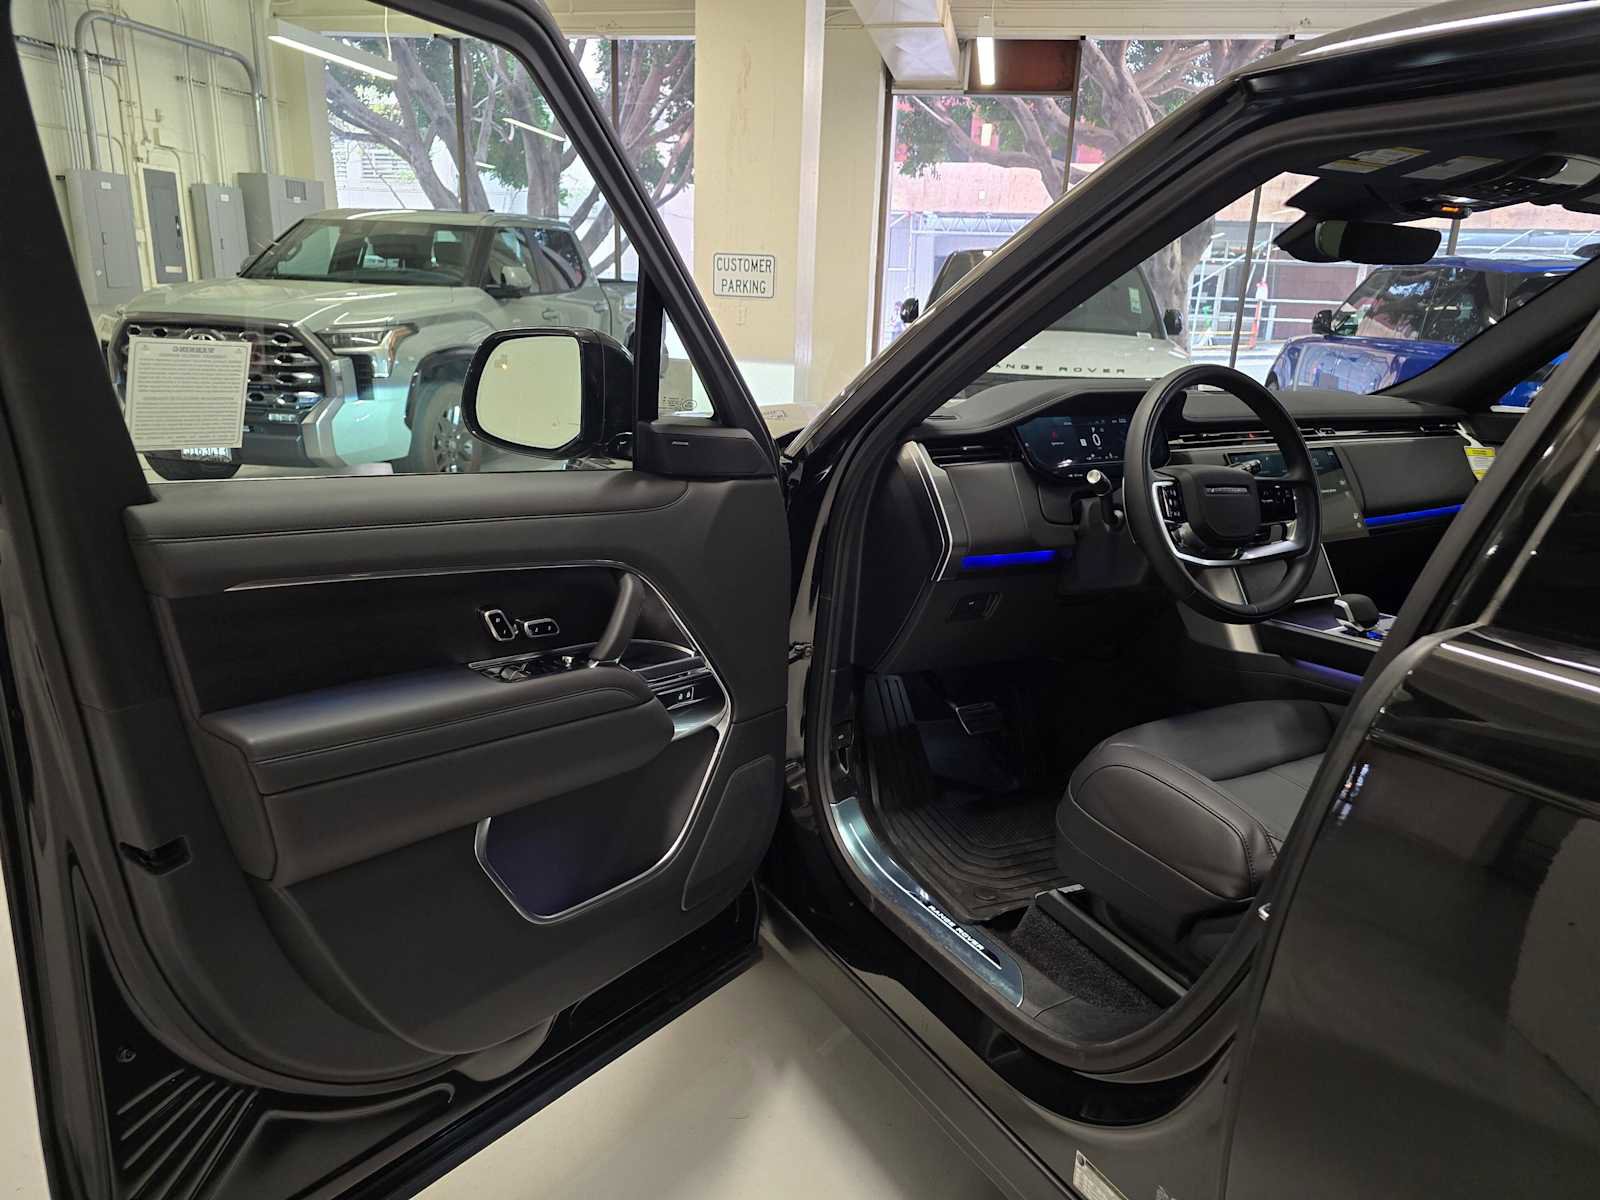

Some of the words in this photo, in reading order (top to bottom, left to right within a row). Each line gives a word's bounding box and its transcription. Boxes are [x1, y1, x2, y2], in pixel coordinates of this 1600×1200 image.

[717, 257, 772, 273] CUSTOMER
[721, 279, 766, 294] PARKING
[995, 363, 1044, 371] ANGE
[1058, 366, 1126, 374] ROVER
[928, 905, 956, 927] RANGE
[955, 927, 984, 950] ROVER
